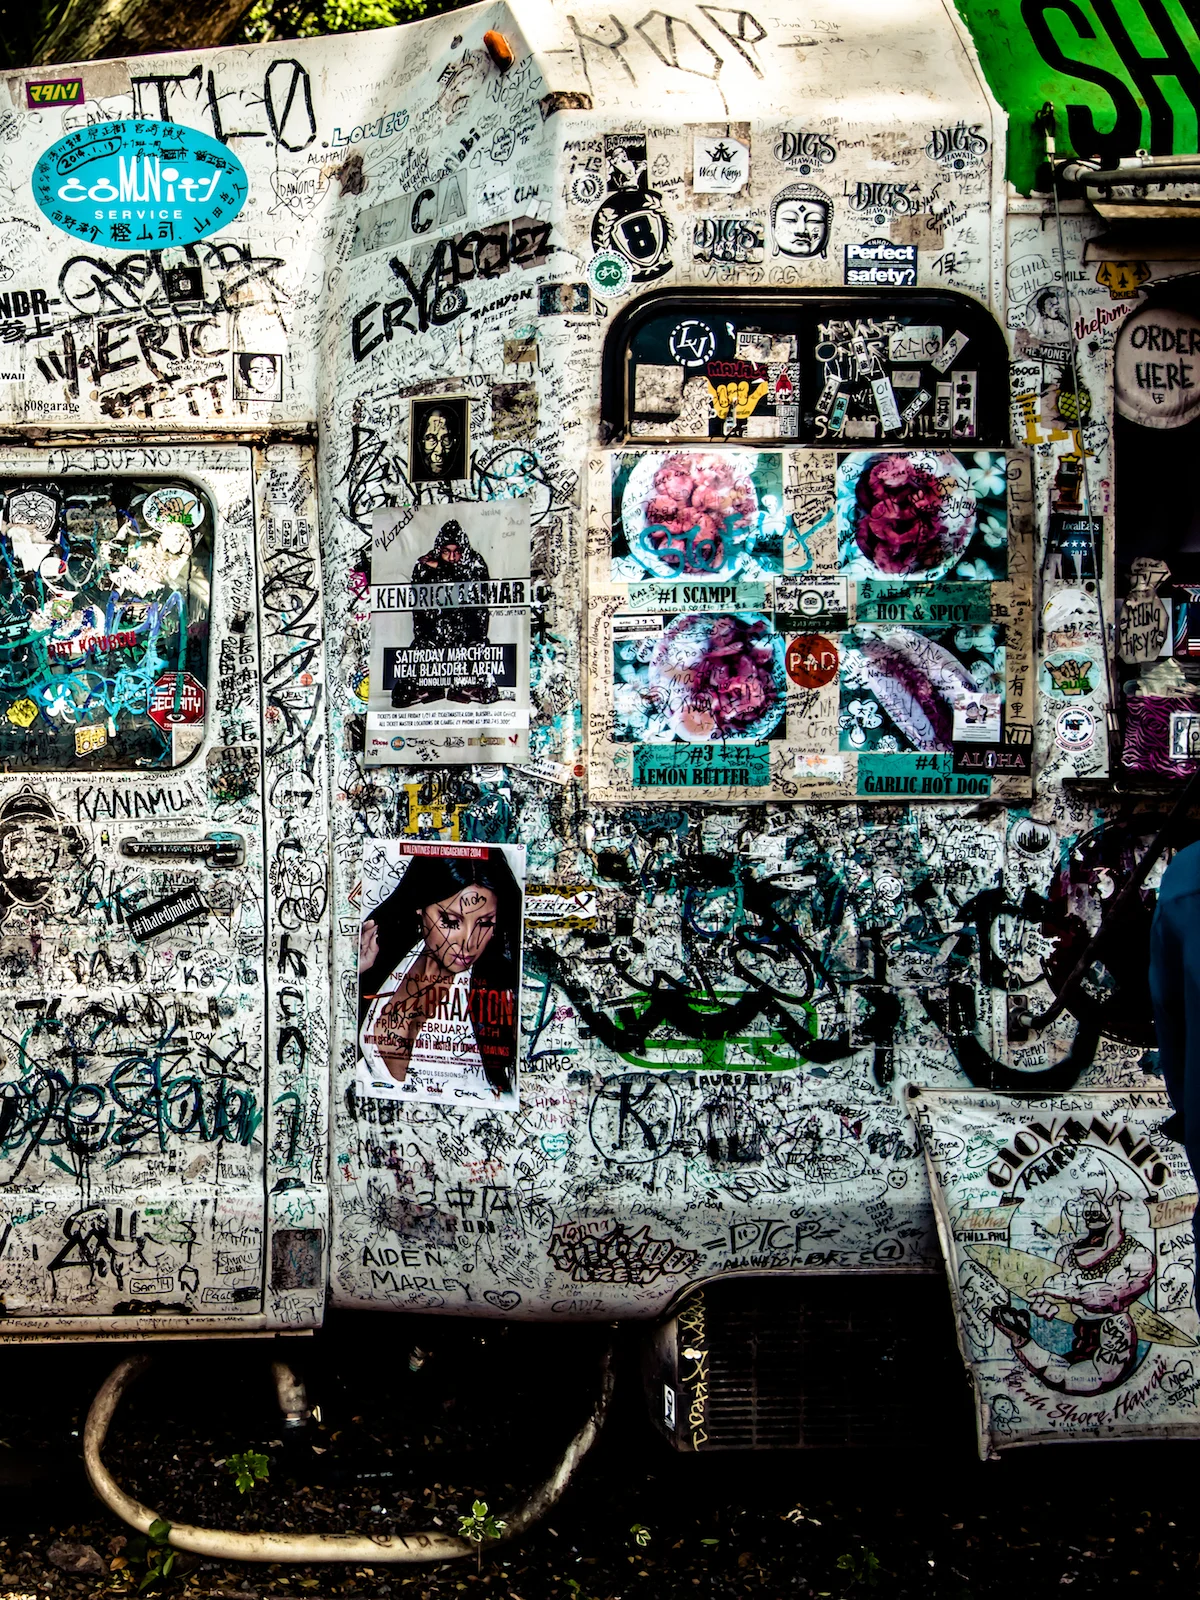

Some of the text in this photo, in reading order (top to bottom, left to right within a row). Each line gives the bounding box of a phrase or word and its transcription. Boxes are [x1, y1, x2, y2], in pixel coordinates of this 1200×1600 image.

[774, 132, 837, 164] DIGS
[926, 125, 988, 162] DIGS
[700, 164, 742, 185] West Kings
[849, 182, 911, 214] DIGS
[95, 210, 183, 219] SERVICE
[694, 219, 765, 249] DIGS
[848, 245, 914, 260] Perfect
[848, 269, 915, 285] safety?
[1041, 349, 1071, 360] MONEY
[708, 361, 768, 378] MAHALO
[1136, 358, 1194, 389] HERE
[24, 400, 79, 414] 808garage
[377, 585, 453, 609] KENDRICK
[658, 587, 737, 603] #1 SCAMPI
[913, 584, 935, 598] #2
[877, 604, 971, 621] HOT & SPICY
[395, 647, 503, 664] SATURDAY MARCH 8TH
[393, 661, 505, 678] NEAL BLAISDELL ARENA
[690, 745, 714, 764] #3
[915, 754, 938, 771] #4
[639, 768, 750, 785] LEMON BUTTER
[864, 776, 989, 794] GARLIC HOT DOG
[131, 892, 200, 936] #ihatedjmiked
[415, 973, 455, 985] BLAISDELL
[426, 986, 513, 1026] BRAXTON
[376, 1018, 413, 1030] FRIDAY
[416, 1021, 469, 1035] FEBRUARY
[1027, 1099, 1082, 1110] KOREA
[362, 1247, 442, 1267] AIDEN
[132, 1282, 156, 1292] Sam
[370, 1270, 472, 1301] MARLEY
[551, 1300, 604, 1313] CADIZ
[1112, 1355, 1168, 1418] Hawaii
